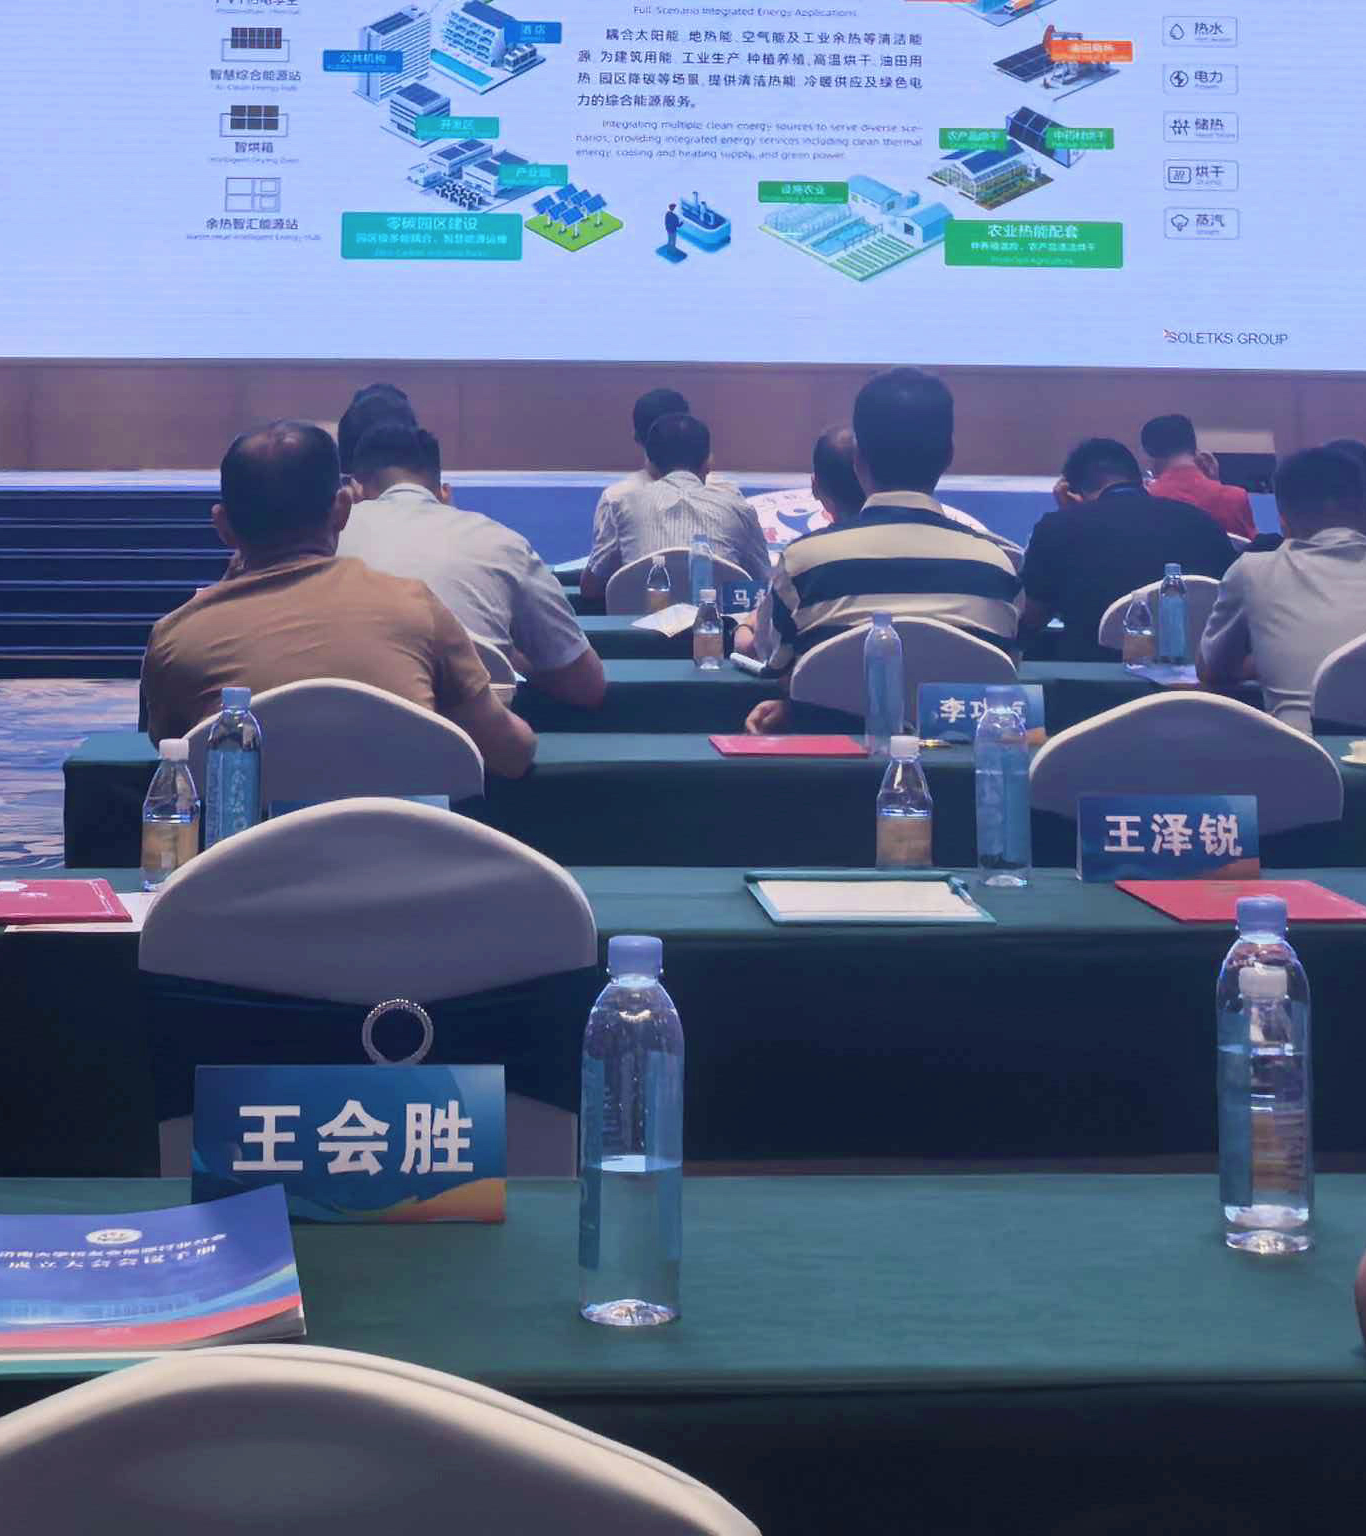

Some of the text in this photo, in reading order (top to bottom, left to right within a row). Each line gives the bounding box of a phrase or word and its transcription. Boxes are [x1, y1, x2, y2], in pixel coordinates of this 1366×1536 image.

[1195, 22, 1224, 35] 热水
[210, 69, 301, 81] 智慧综合能源站
[1194, 70, 1223, 84] 电力
[1195, 166, 1225, 178] 烘干
[1167, 332, 1288, 345] SOLETKS GROUP
[1104, 813, 1243, 857] 王泽锐
[233, 1099, 475, 1176] 王会胜
